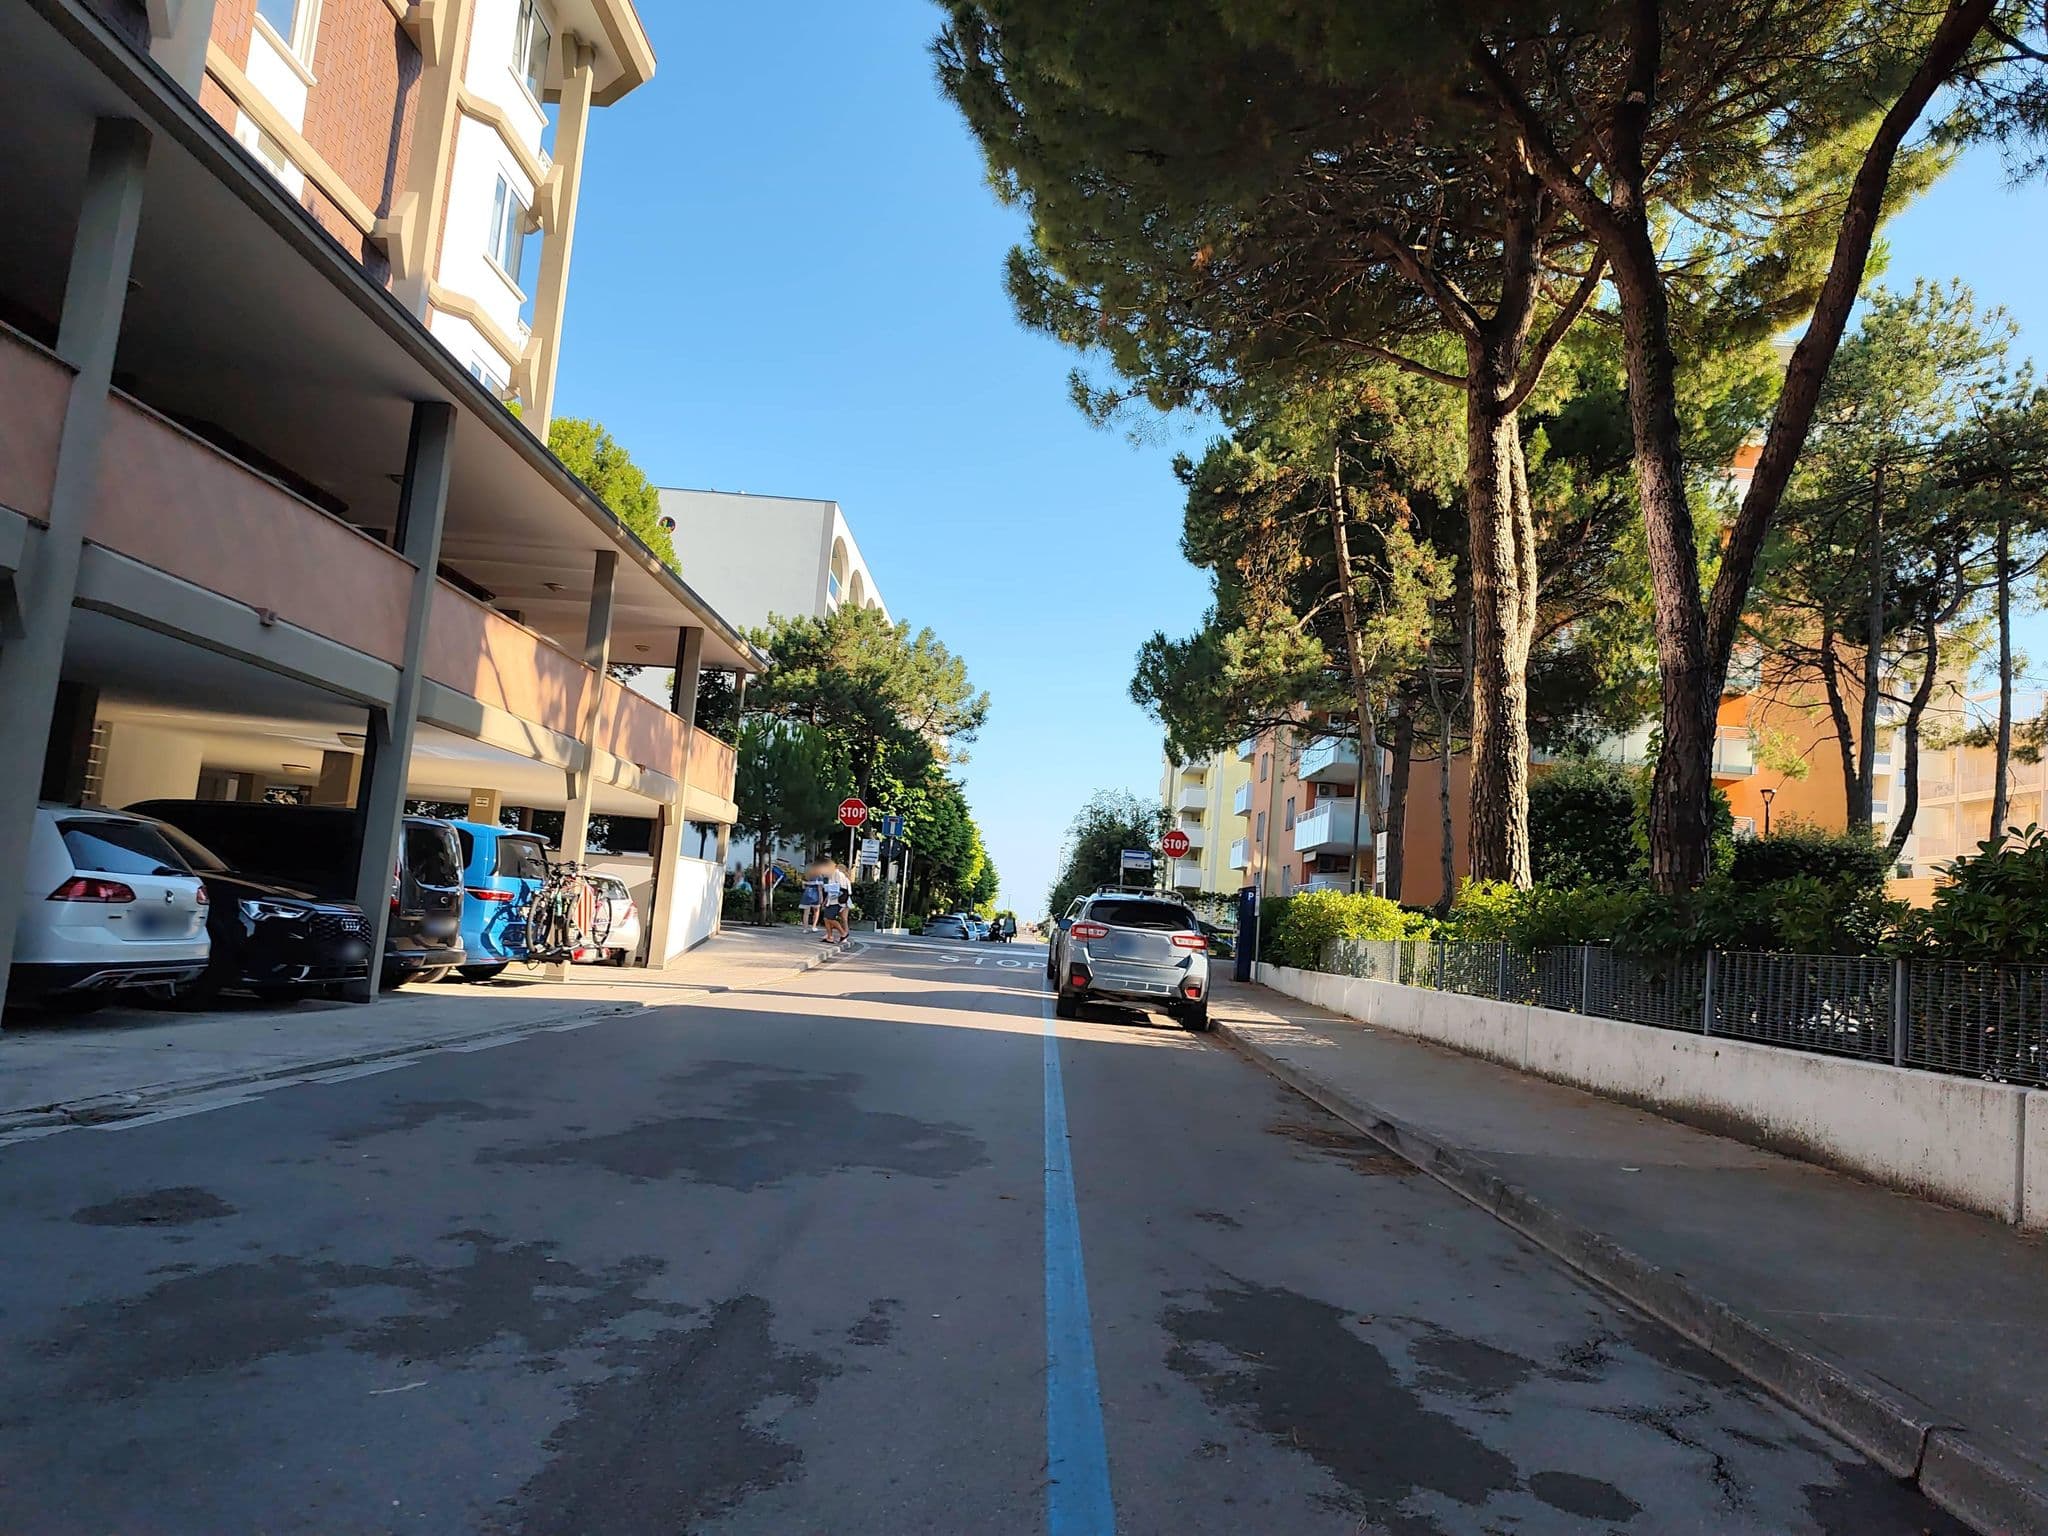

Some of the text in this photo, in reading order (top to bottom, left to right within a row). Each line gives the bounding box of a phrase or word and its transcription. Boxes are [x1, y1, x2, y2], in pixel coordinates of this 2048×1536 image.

[840, 807, 866, 818] STOP
[1163, 838, 1188, 850] STOP
[1247, 892, 1255, 900] P
[938, 955, 1048, 969] STOP
